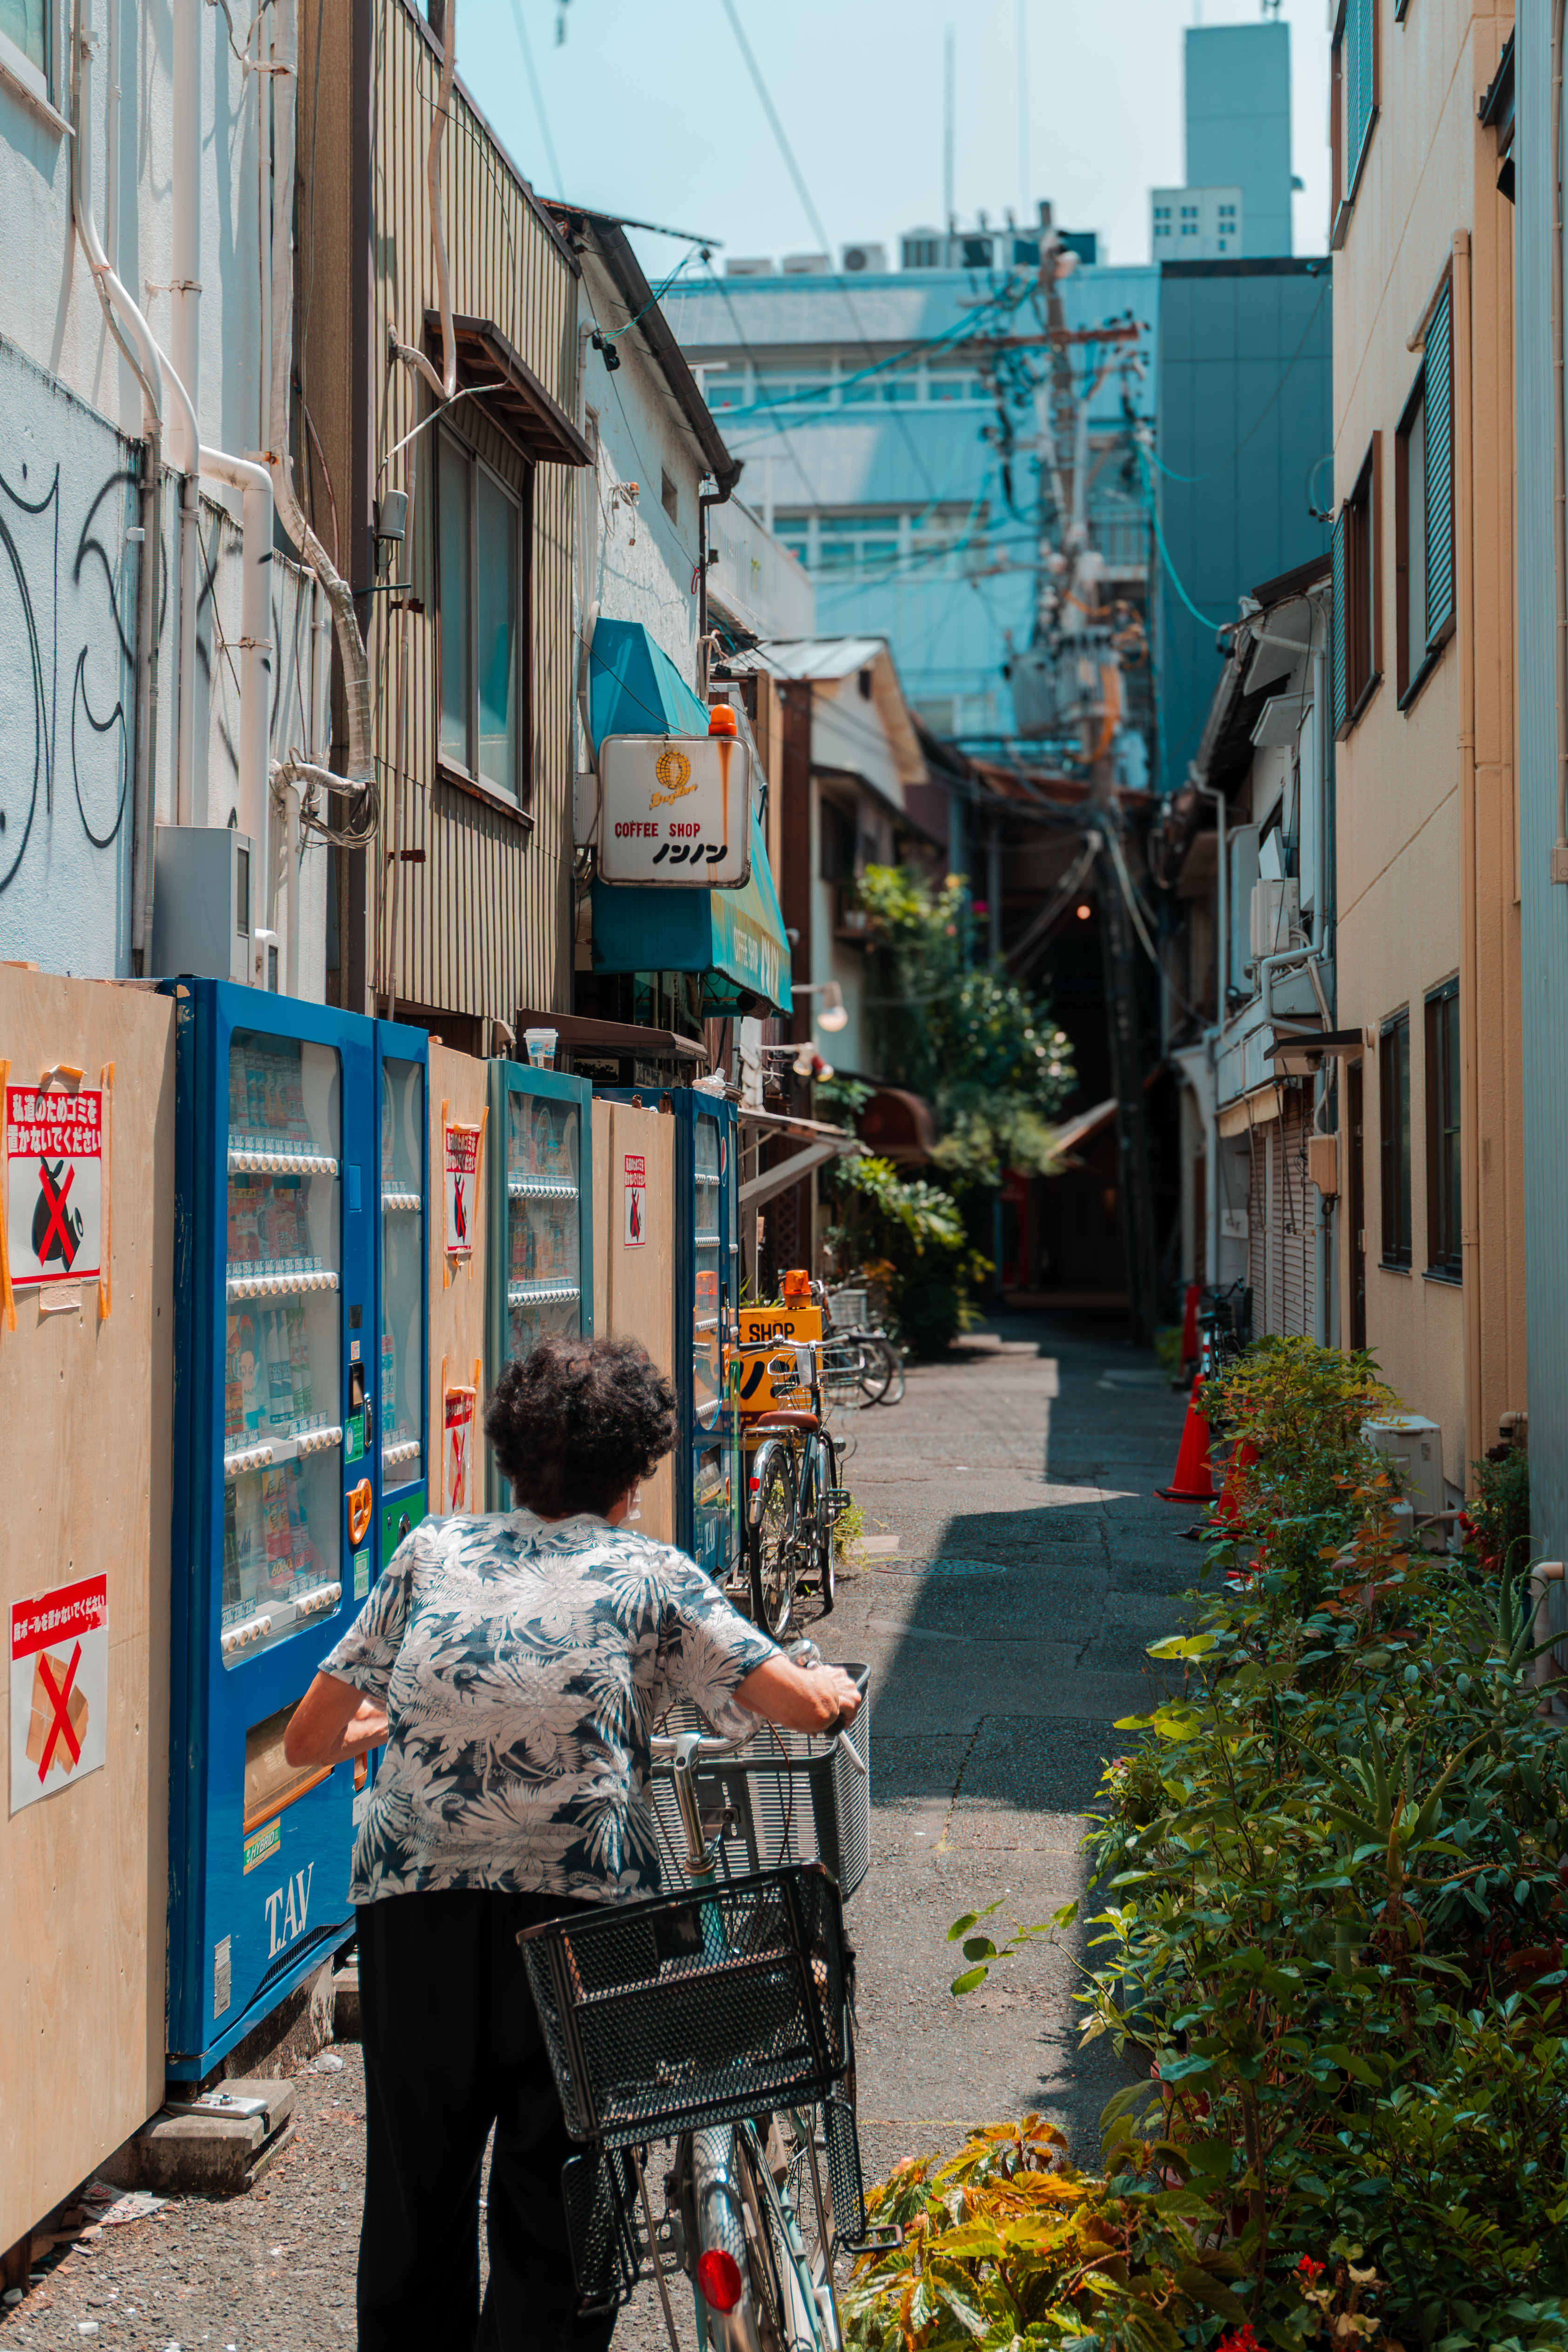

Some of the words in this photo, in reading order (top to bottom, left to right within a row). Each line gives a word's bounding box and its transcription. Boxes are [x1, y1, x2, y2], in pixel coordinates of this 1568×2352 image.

[649, 783, 698, 811] Brazilian
[615, 822, 659, 837] COFFEE
[669, 822, 700, 837] SHOP
[13, 1093, 97, 1124] 私道のためゴミを
[7, 1125, 101, 1153] 置かないでください
[749, 1322, 795, 1342] SHOP
[13, 1595, 105, 1643] 段ボールを置かないでください
[250, 1831, 275, 1861] HYBRID
